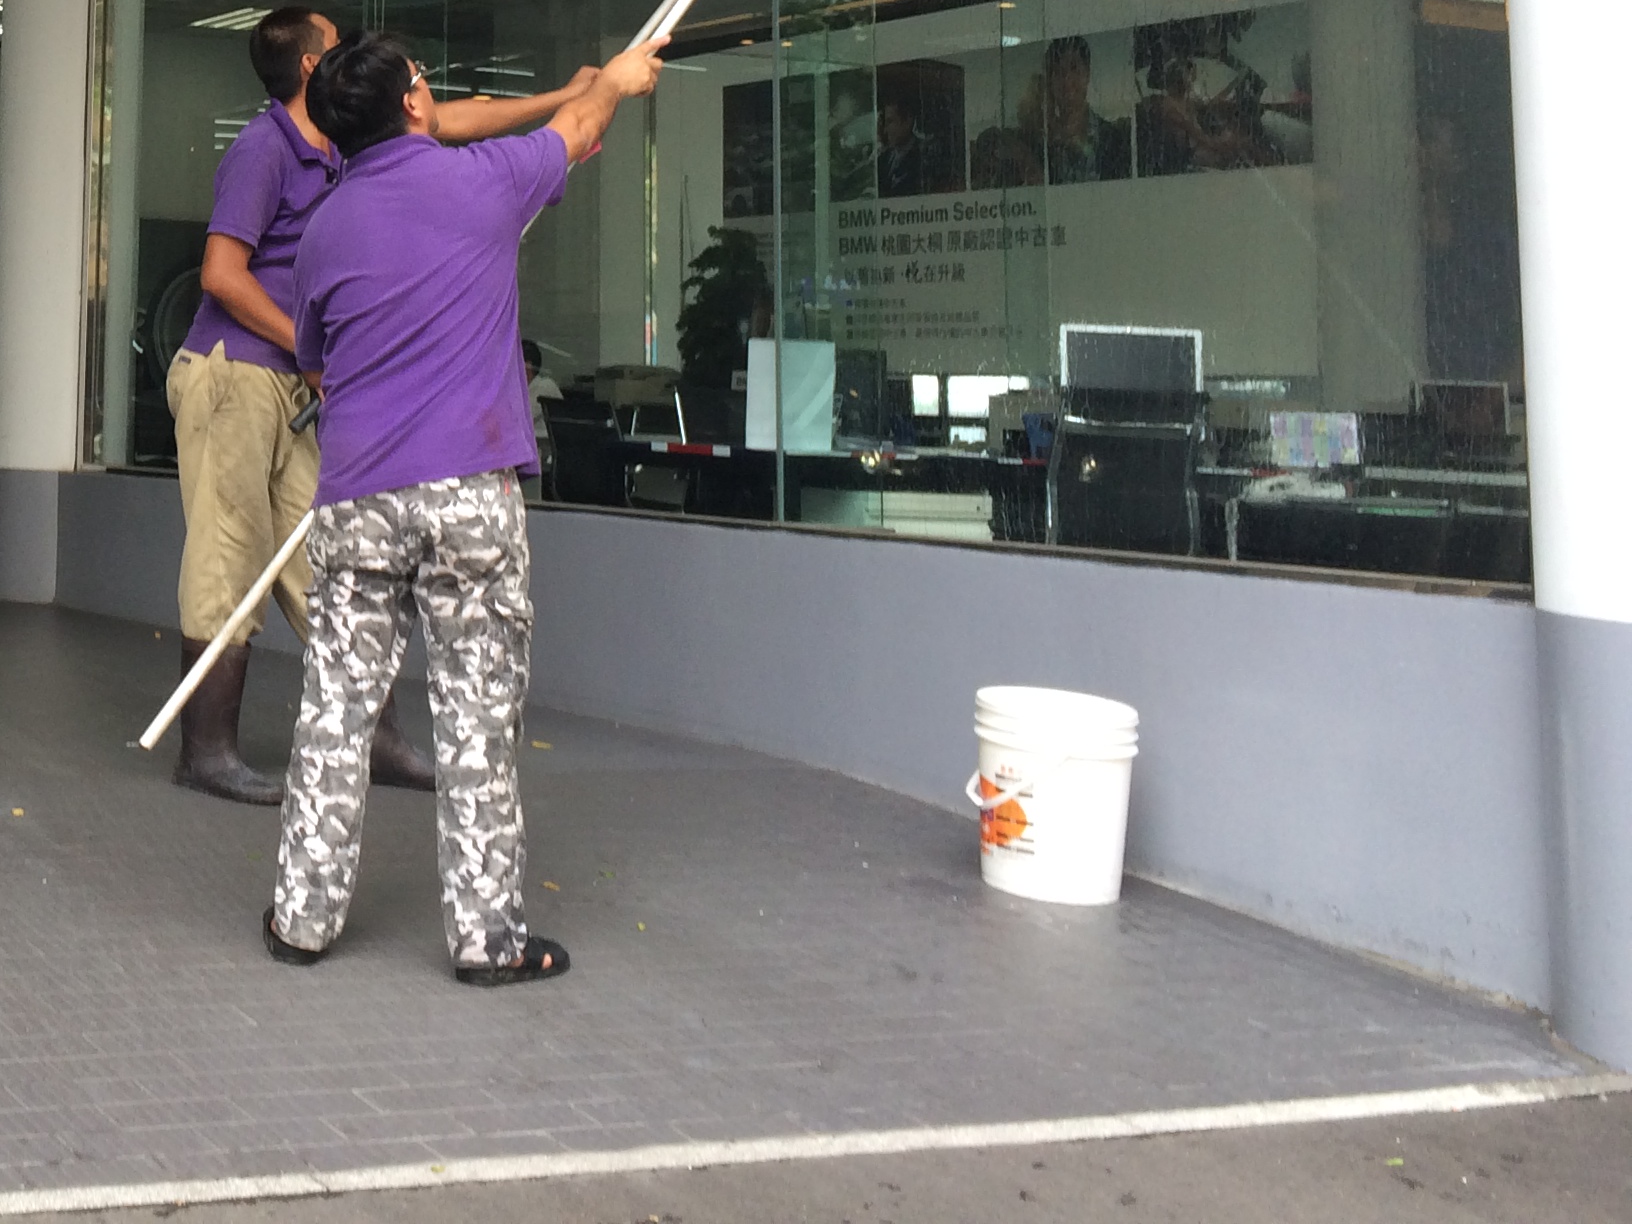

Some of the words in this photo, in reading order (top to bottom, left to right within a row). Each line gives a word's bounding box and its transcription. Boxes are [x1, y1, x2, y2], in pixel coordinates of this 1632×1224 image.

[838, 209, 878, 229] BMW
[880, 205, 949, 226] Premium
[953, 199, 1038, 222] Selection.
[838, 235, 878, 256] BMW
